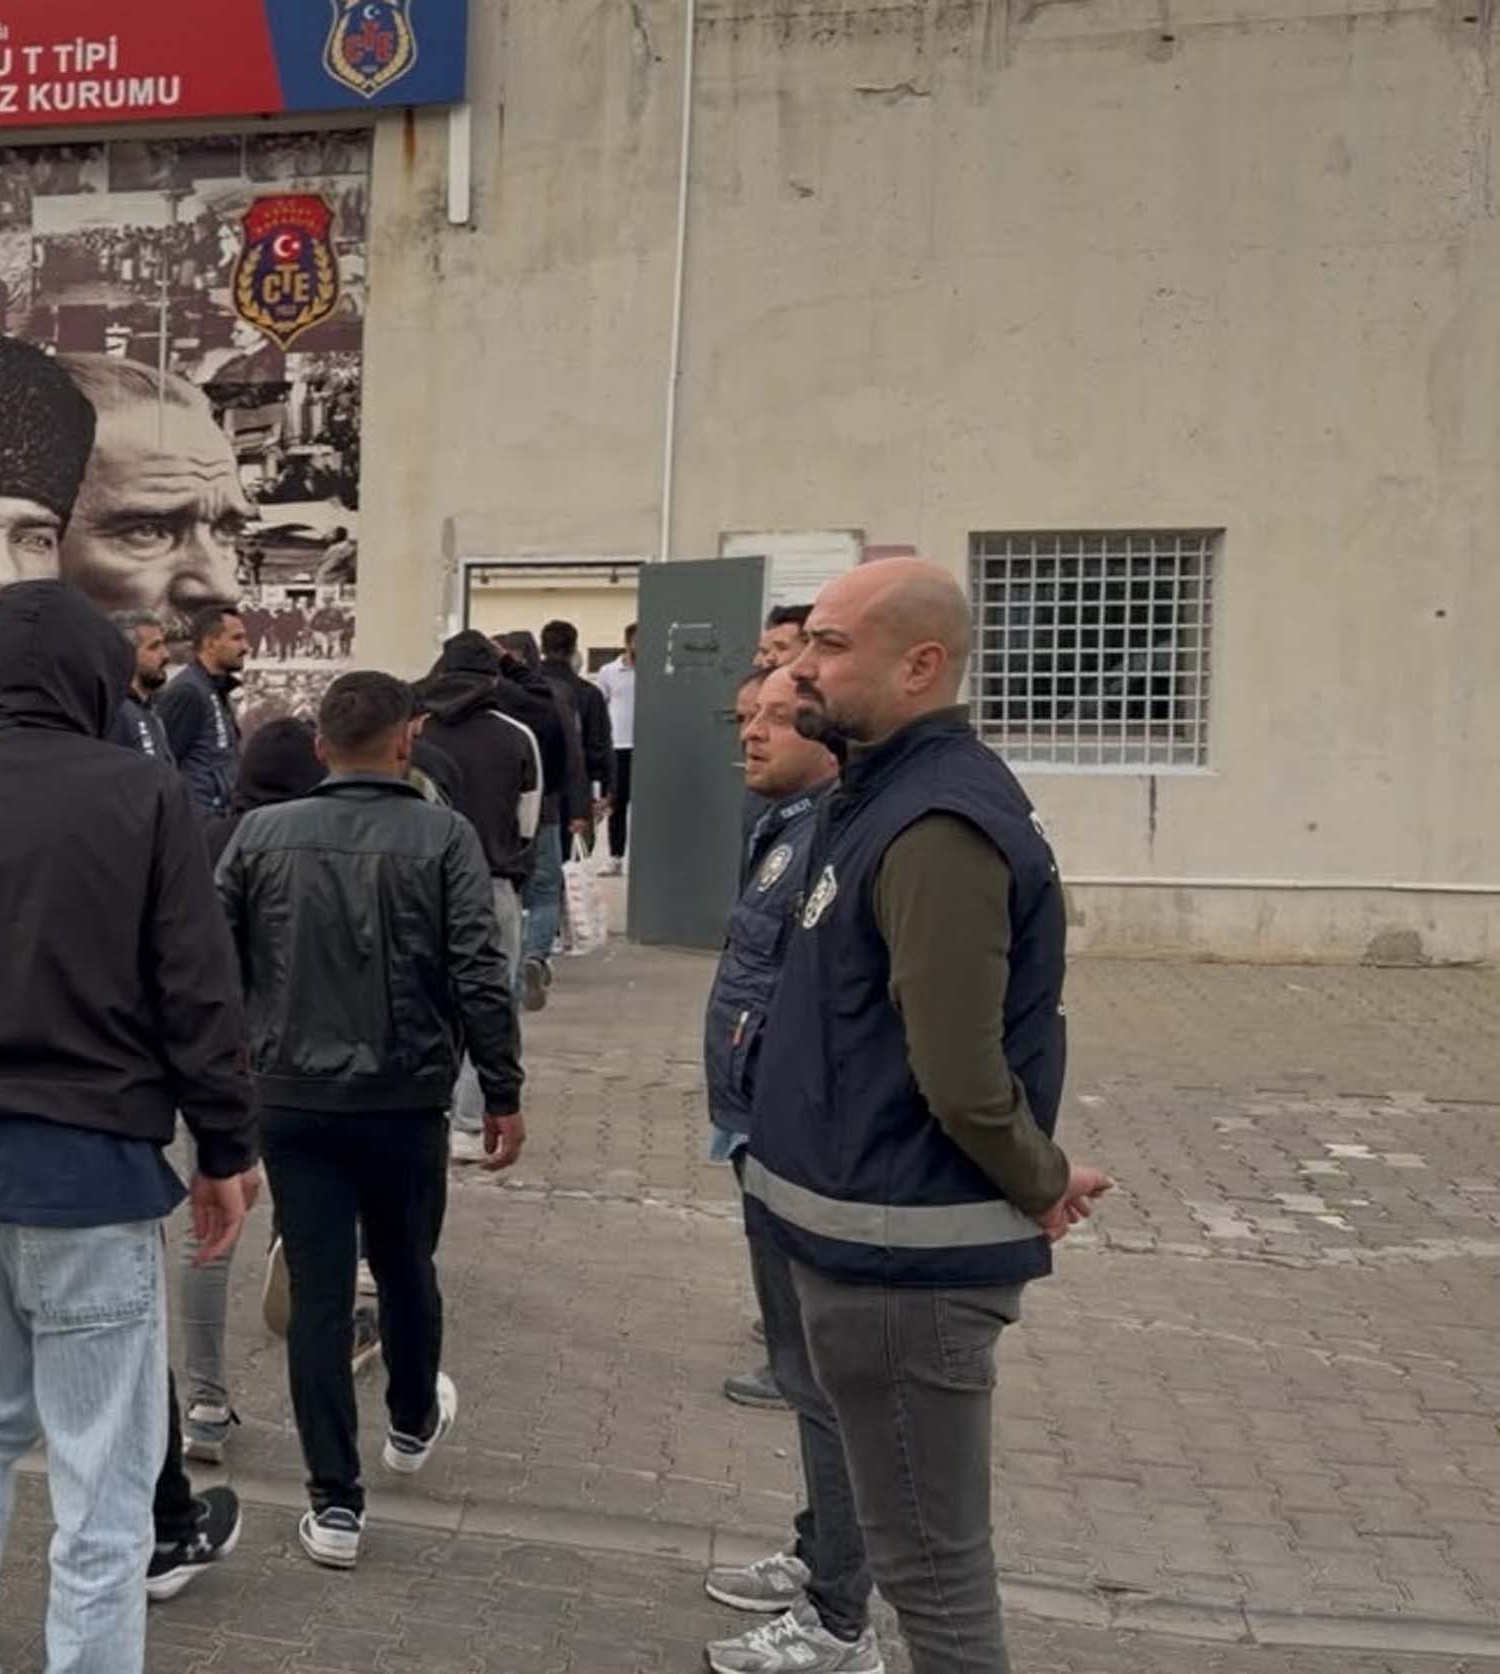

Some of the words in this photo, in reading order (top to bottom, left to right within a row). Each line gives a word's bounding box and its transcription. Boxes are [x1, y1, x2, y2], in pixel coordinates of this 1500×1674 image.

[22, 46, 43, 74] T
[52, 35, 117, 73] TİPİ
[29, 75, 180, 111] KURUMU
[262, 264, 310, 303] CTE
